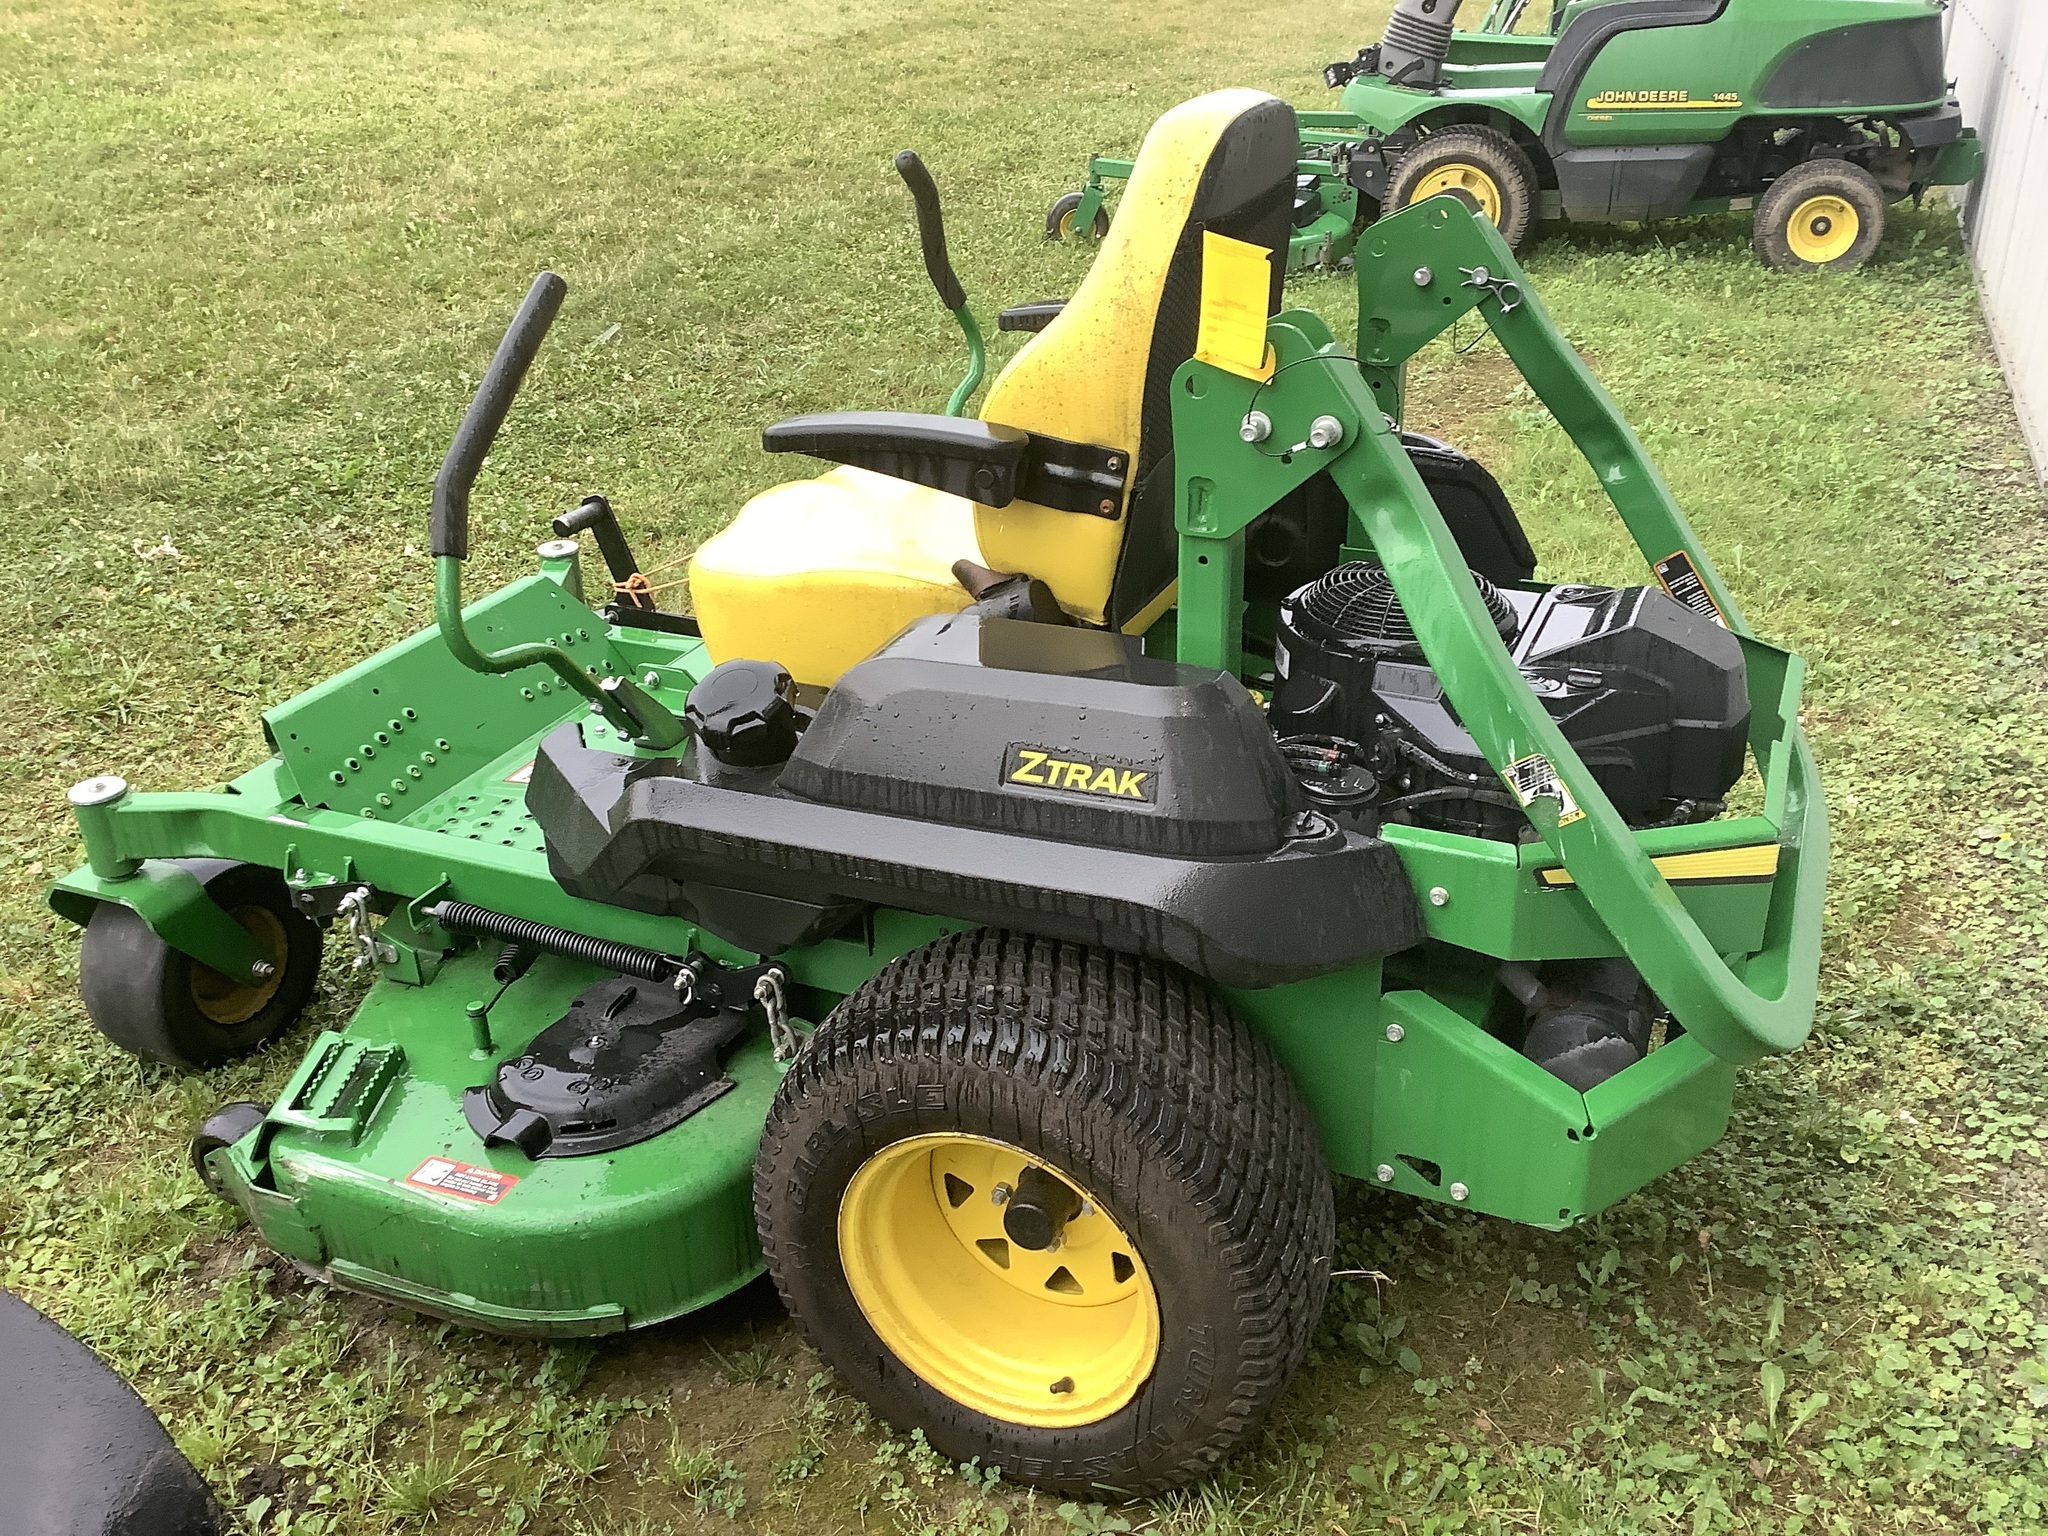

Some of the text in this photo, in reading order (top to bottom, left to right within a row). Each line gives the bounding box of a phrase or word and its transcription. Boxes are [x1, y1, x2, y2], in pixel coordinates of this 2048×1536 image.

[1596, 90, 1738, 103] JOHN DEERE 1445
[1011, 750, 1147, 797] ZTRAK
[784, 1084, 946, 1213] CARLISLE
[1173, 1323, 1216, 1430] TURF
